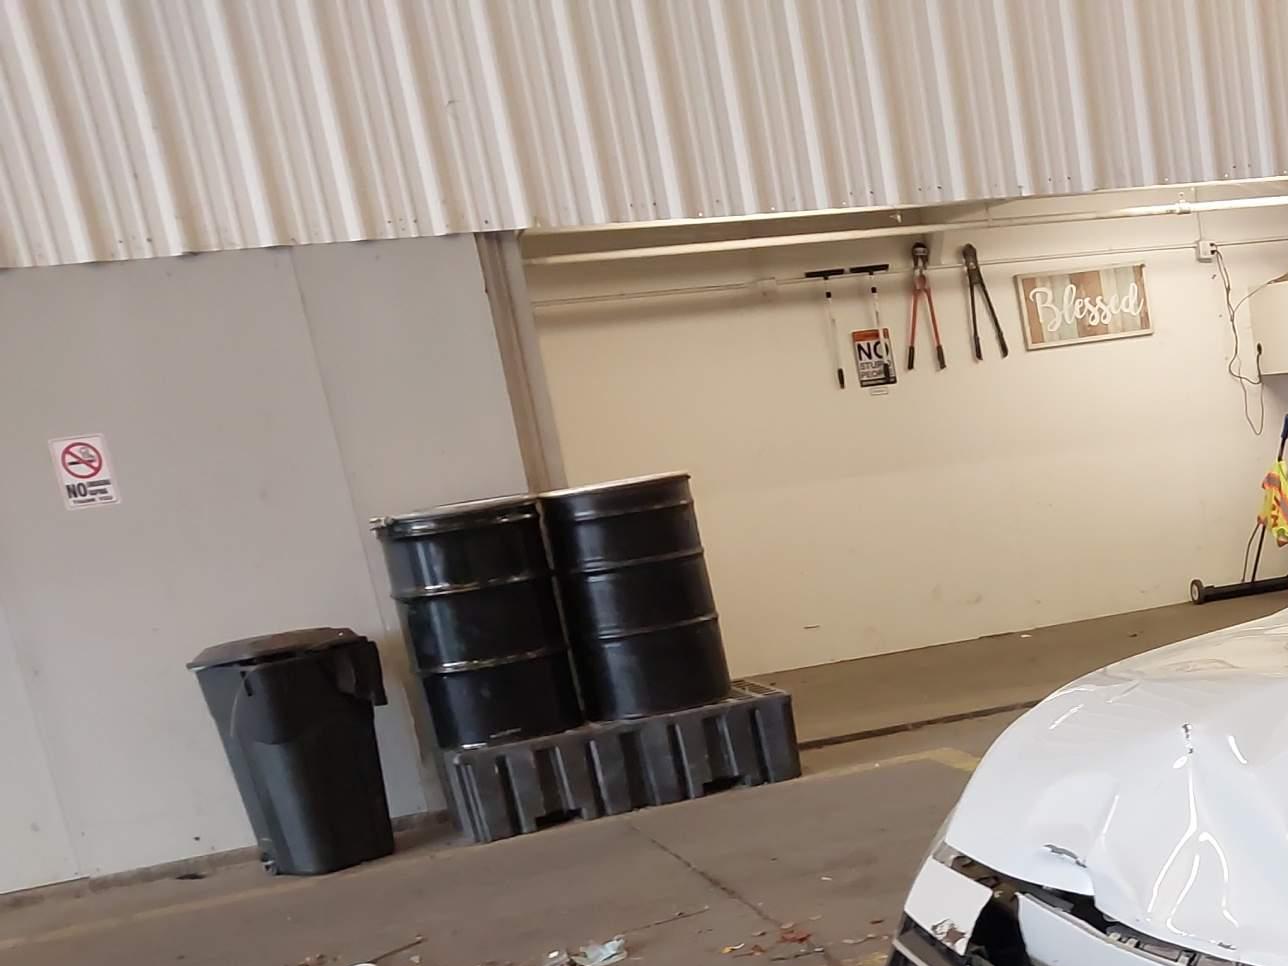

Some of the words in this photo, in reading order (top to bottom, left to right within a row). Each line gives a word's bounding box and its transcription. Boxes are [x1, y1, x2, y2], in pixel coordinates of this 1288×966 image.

[1029, 282, 1144, 332] Blessed
[857, 341, 889, 361] NO
[859, 360, 891, 370] STUPD
[66, 482, 88, 499] NO
